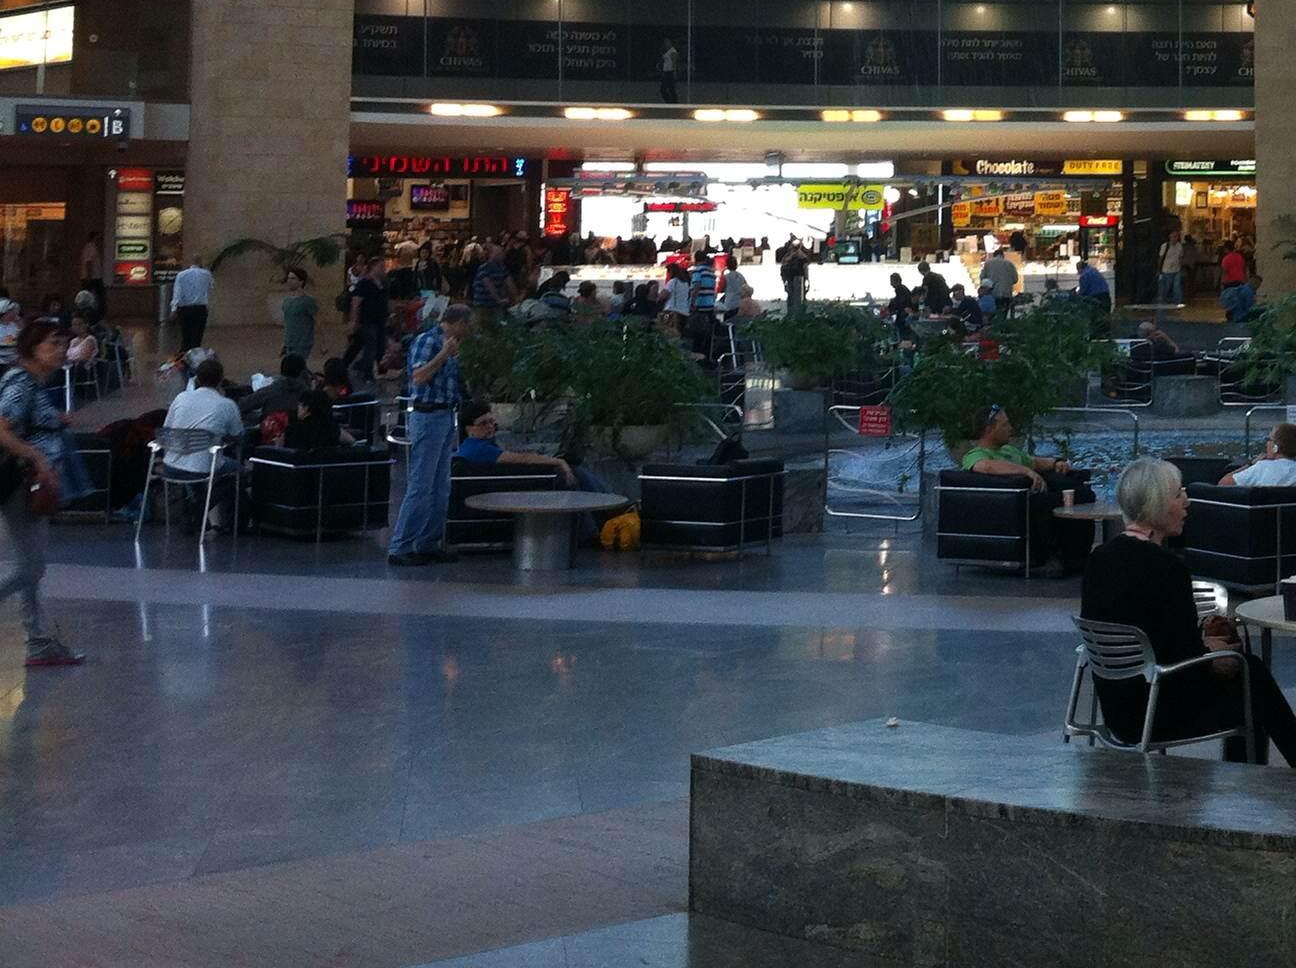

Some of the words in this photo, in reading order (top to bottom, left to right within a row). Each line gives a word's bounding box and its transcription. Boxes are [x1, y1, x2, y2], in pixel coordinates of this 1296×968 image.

[860, 65, 900, 75] CHIVAS
[112, 120, 124, 135] B
[976, 160, 1034, 175] Chocolate
